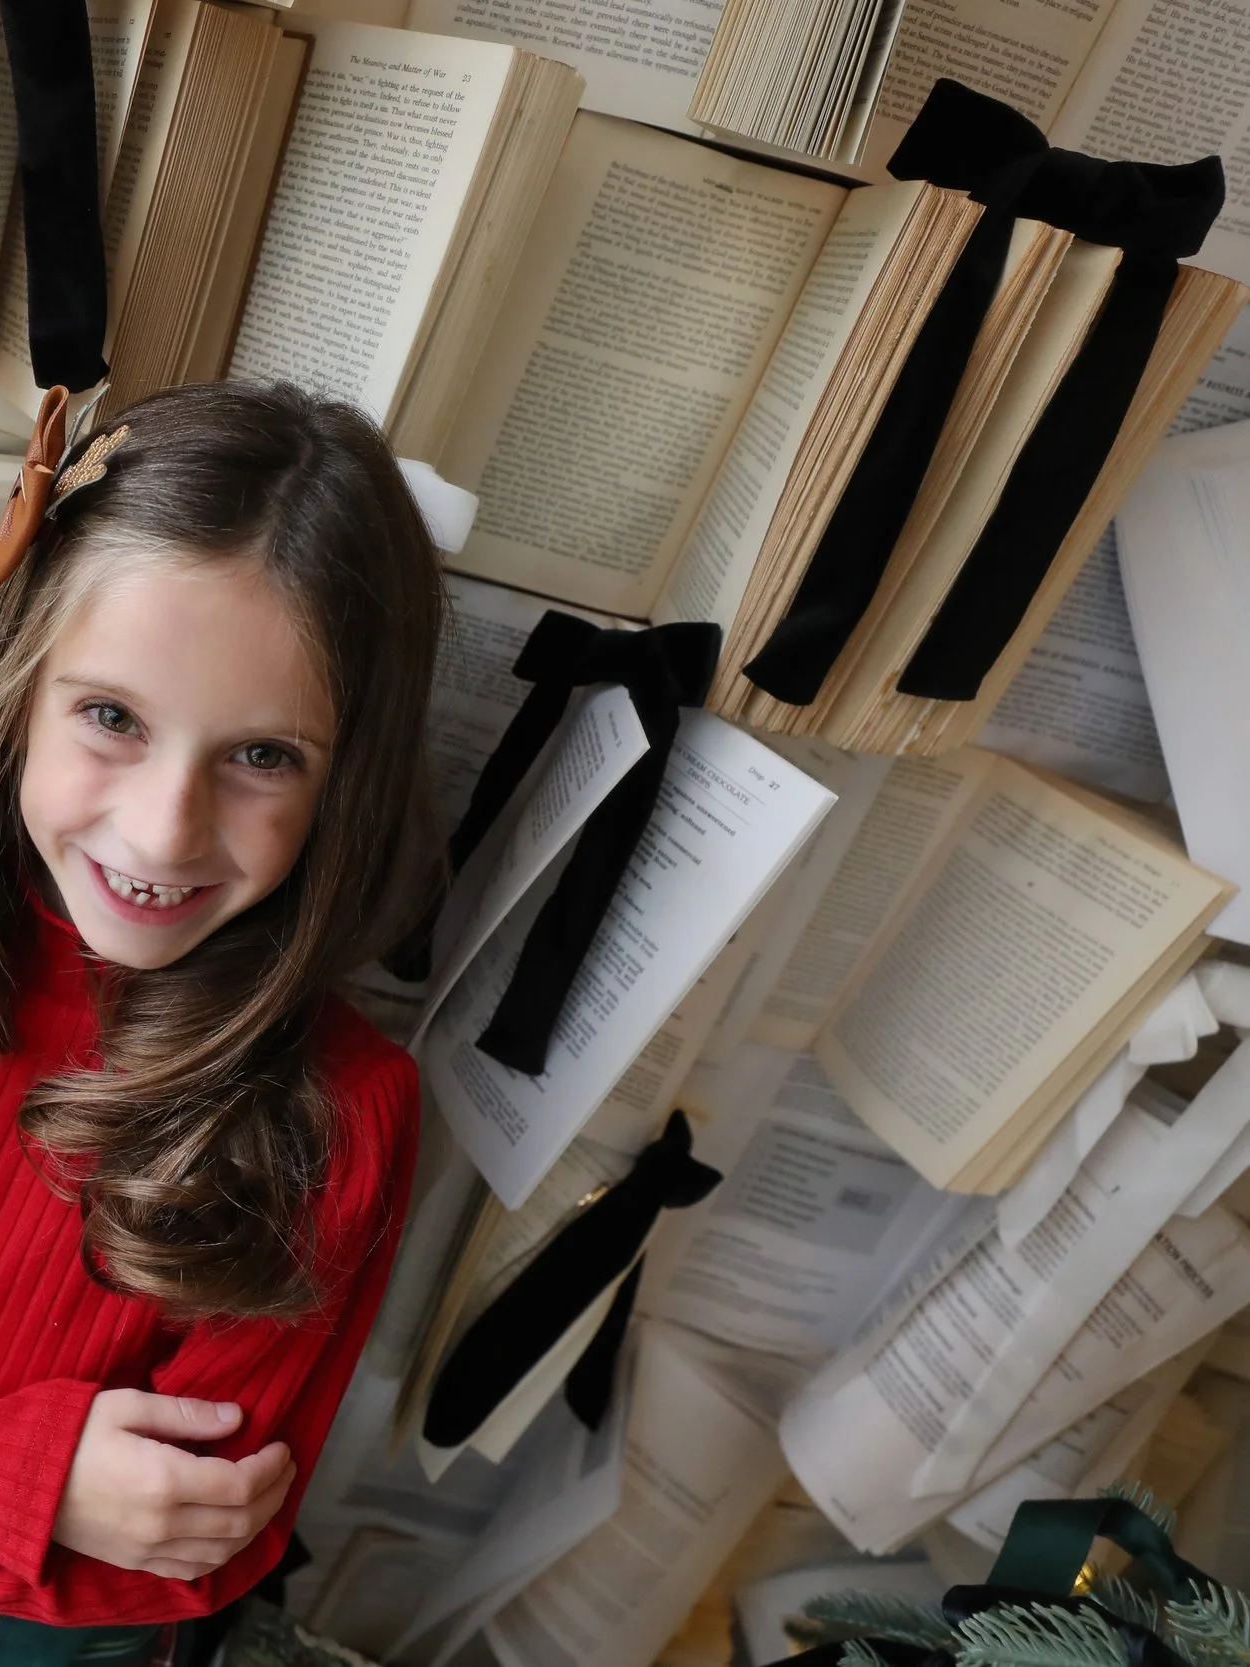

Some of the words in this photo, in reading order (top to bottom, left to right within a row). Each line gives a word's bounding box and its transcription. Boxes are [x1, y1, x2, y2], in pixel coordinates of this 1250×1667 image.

[579, 6, 594, 16] that
[350, 55, 361, 64] The
[362, 57, 387, 71] Meaning
[388, 60, 400, 70] and
[402, 64, 422, 75] Matter
[423, 68, 431, 77] of
[433, 69, 447, 79] War
[462, 74, 471, 83] 23
[410, 84, 420, 93] the
[422, 88, 444, 98] request
[455, 92, 465, 101] the
[412, 99, 430, 109] refuse
[440, 103, 462, 114] follow
[391, 106, 406, 116] Thus
[407, 110, 422, 119] what
[423, 113, 438, 122] must
[439, 117, 457, 126] never
[404, 121, 430, 134] becomes
[431, 127, 454, 138] blessed
[706, 768, 750, 806] CHOCOLATE
[768, 780, 780, 791] 27
